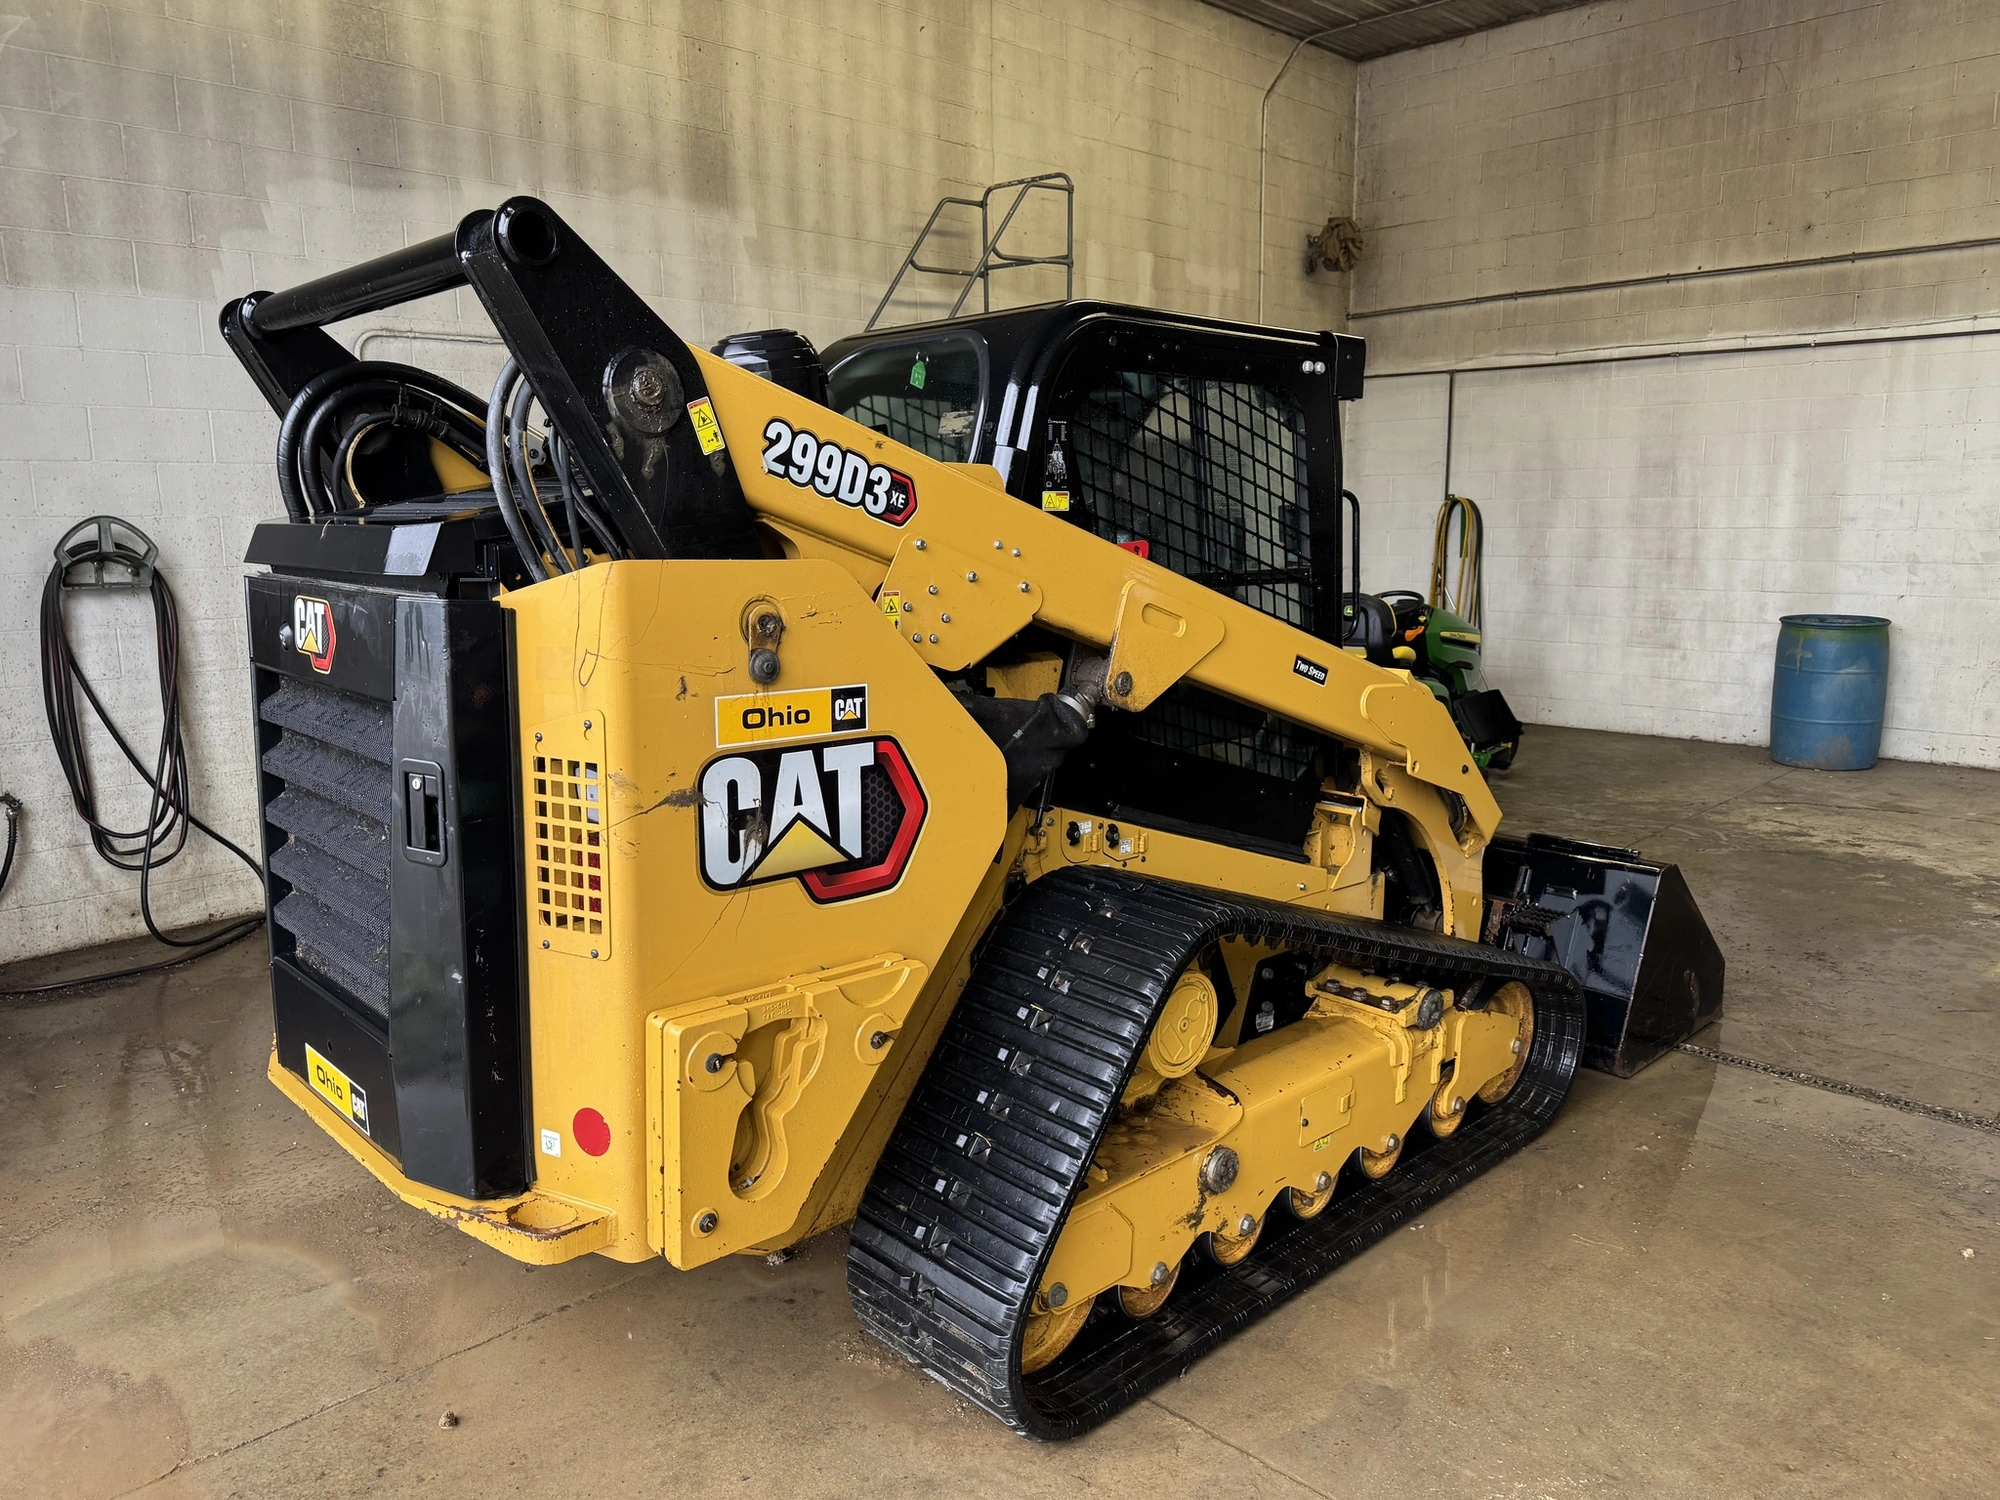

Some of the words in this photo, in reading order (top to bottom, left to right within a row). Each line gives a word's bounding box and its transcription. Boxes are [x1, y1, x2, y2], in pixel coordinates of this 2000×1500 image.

[763, 421, 892, 515] 299D3
[889, 490, 906, 509] XE
[294, 598, 325, 655] CAT
[741, 705, 811, 730] Ohio
[834, 697, 864, 721] CAT
[702, 742, 875, 885] CAT
[316, 1064, 343, 1101] Ohio
[351, 1092, 366, 1121] CAT
